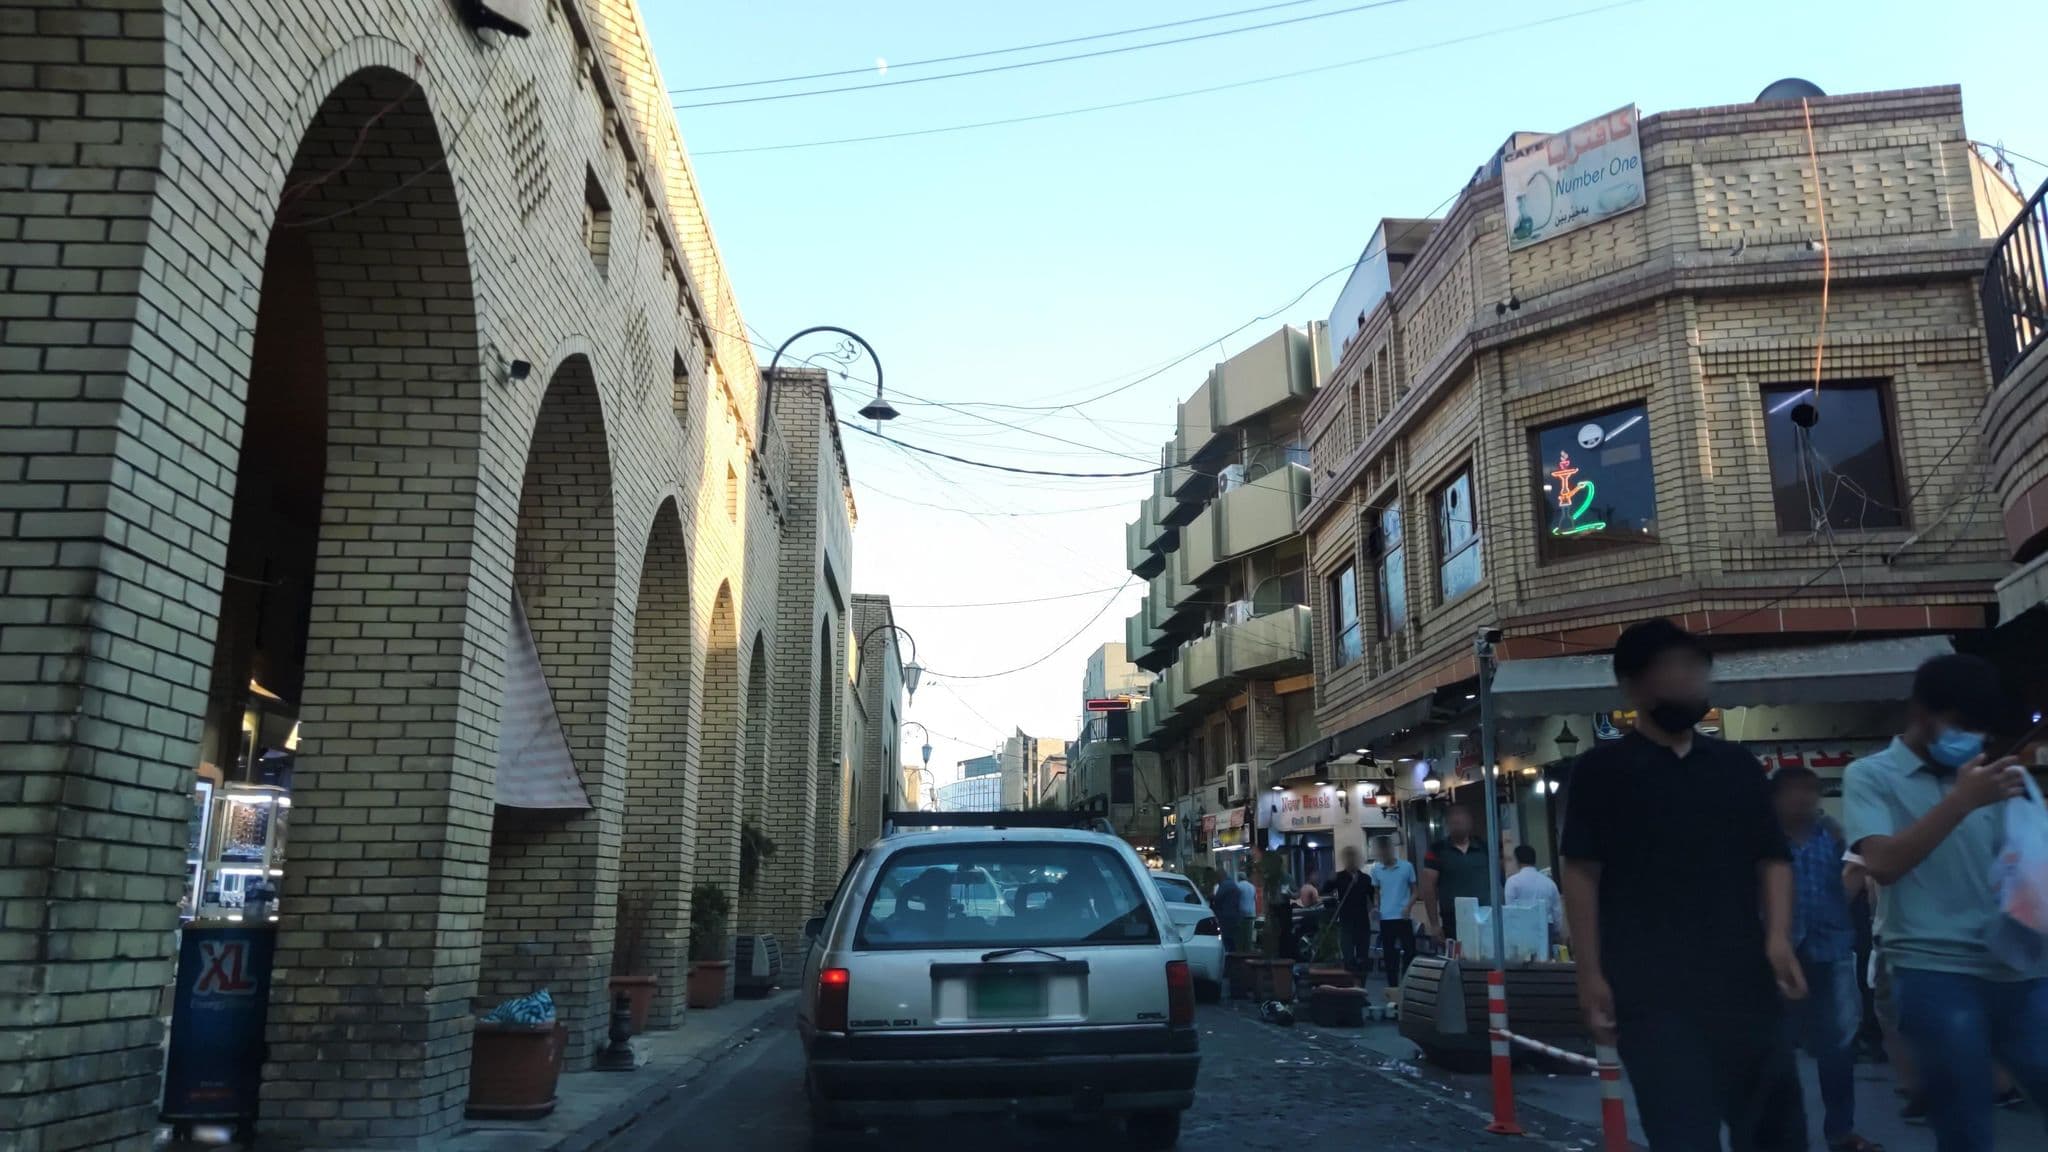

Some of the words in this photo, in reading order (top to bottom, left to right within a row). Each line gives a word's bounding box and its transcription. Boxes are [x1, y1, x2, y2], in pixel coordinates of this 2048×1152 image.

[1555, 166, 1605, 198] Number
[1609, 155, 1639, 176] One
[1281, 797, 1301, 814] New
[195, 941, 255, 994] XL
